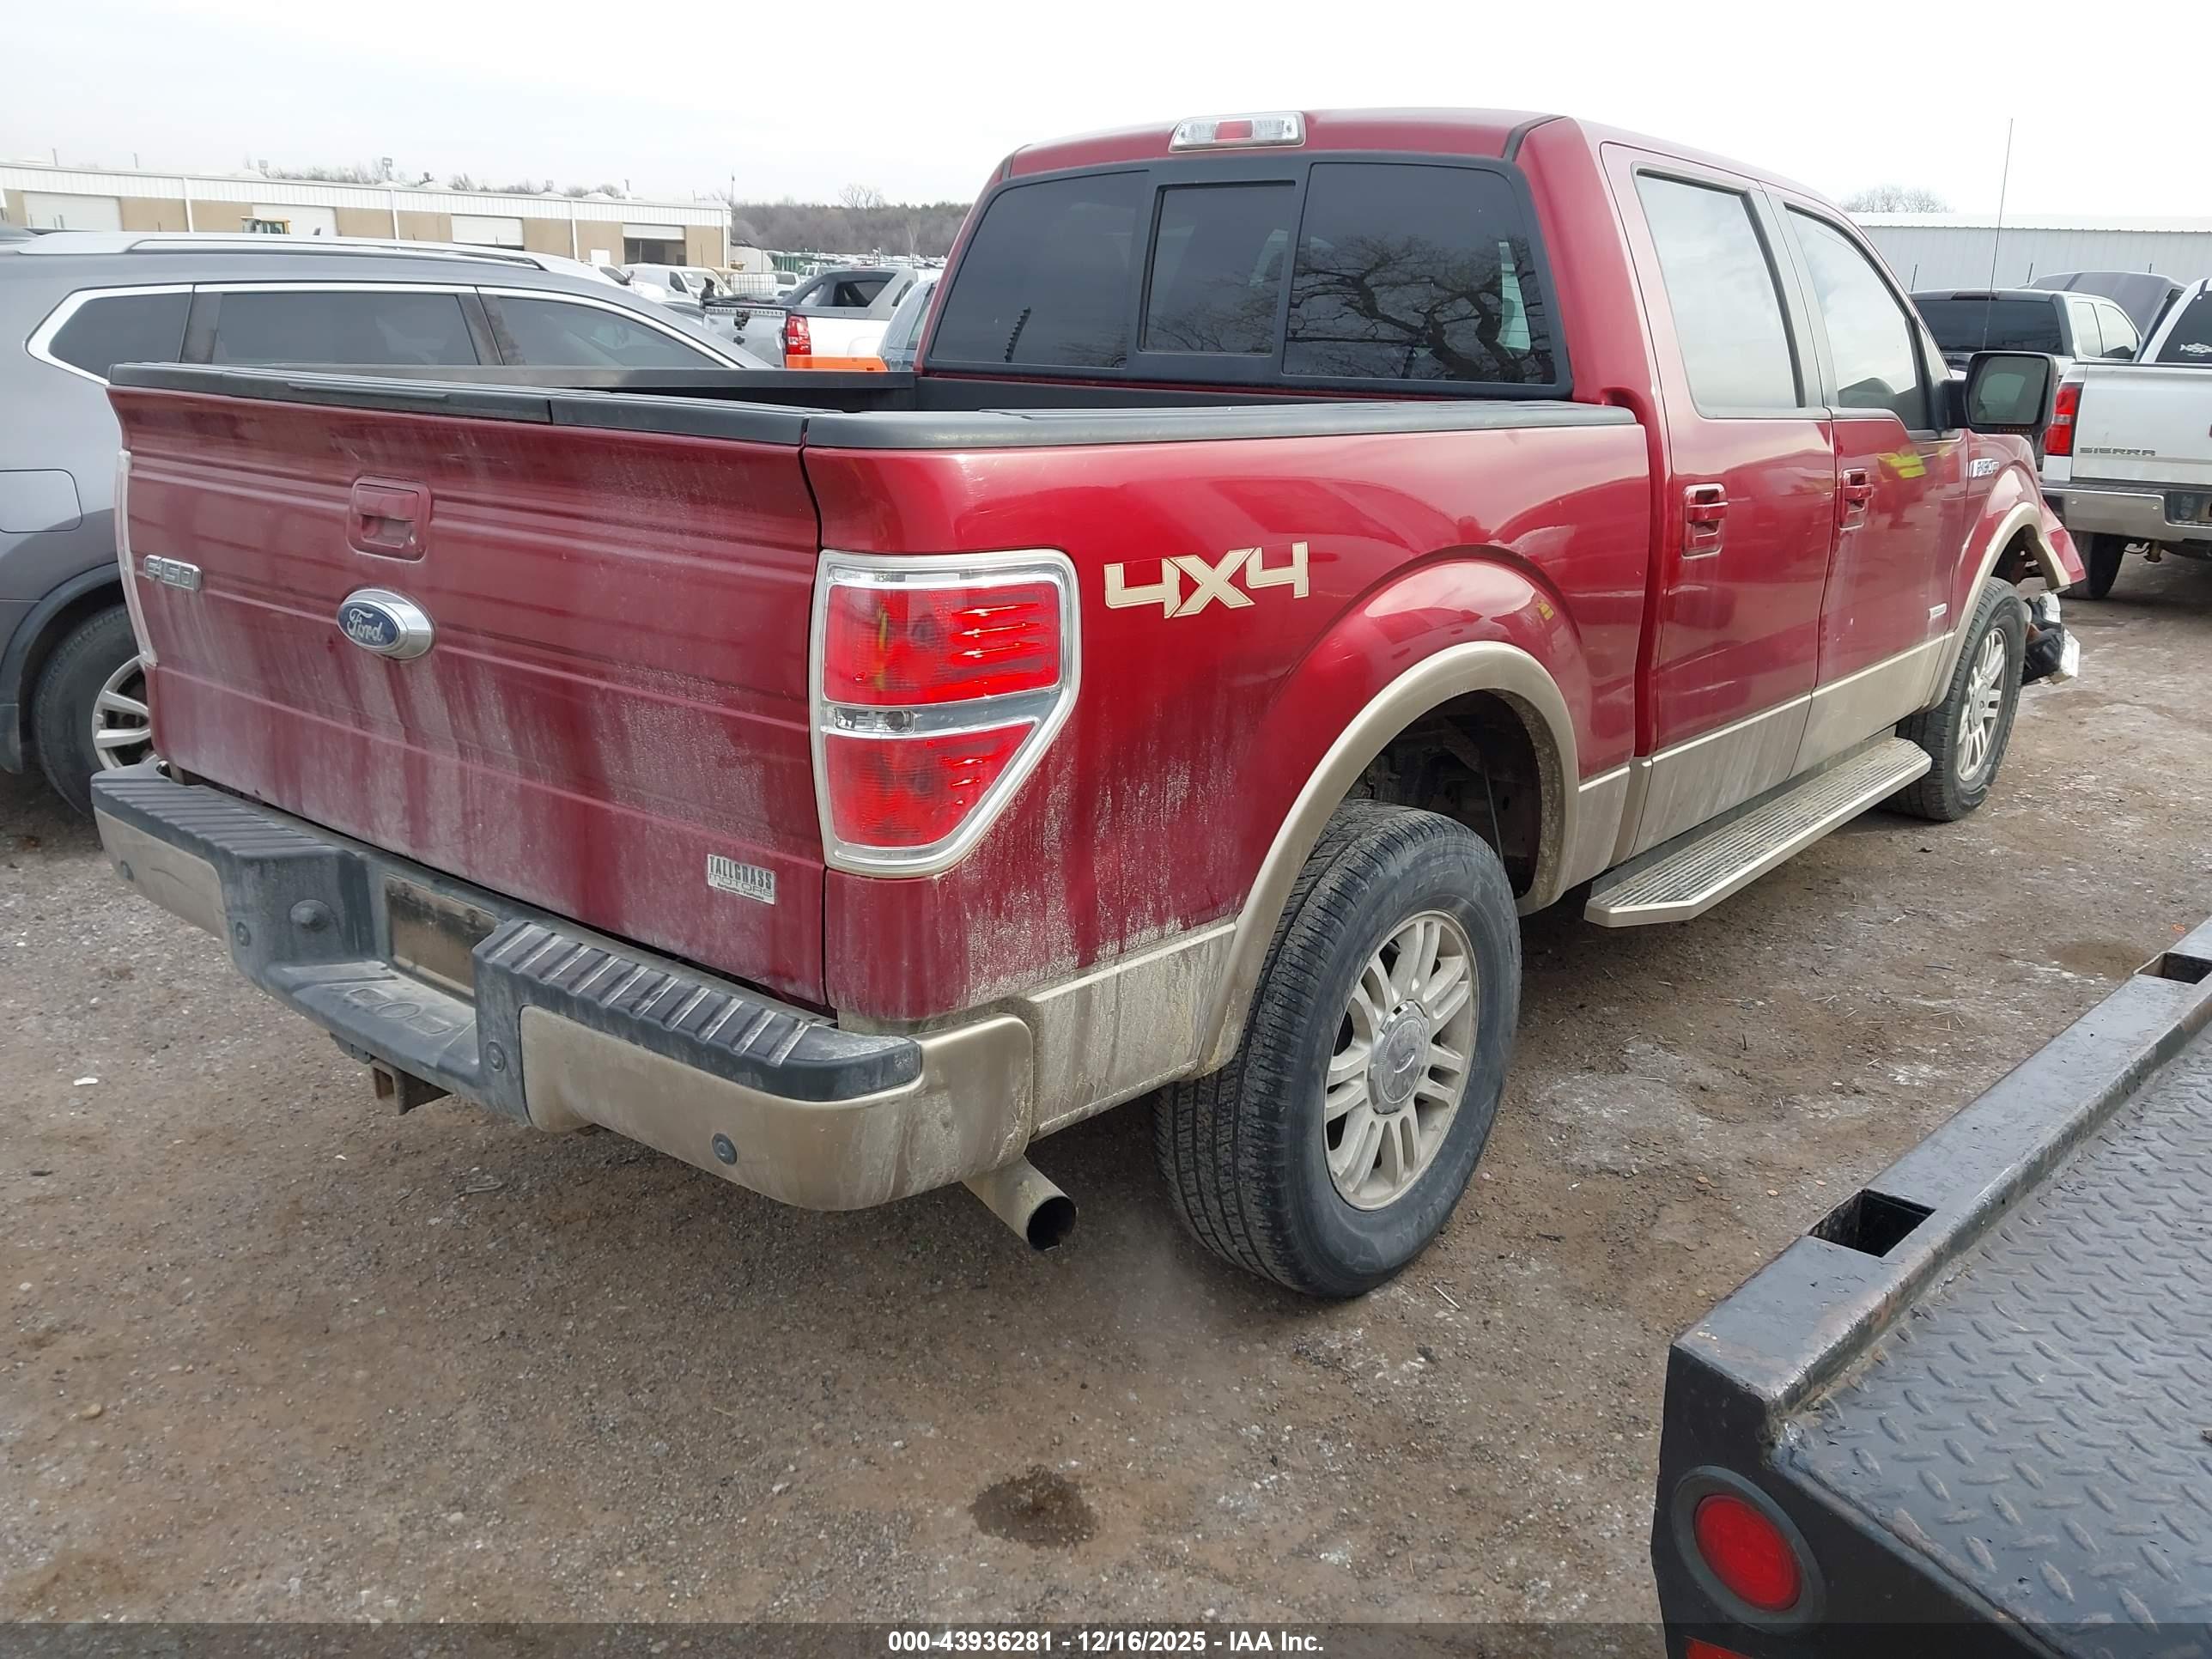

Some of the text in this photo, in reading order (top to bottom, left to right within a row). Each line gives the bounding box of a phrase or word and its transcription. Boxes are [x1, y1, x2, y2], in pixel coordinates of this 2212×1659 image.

[2079, 447, 2156, 457] SIERRA
[346, 607, 385, 642] Ford
[708, 872, 774, 897] MOTORS
[709, 855, 772, 890] TALLGRASS
